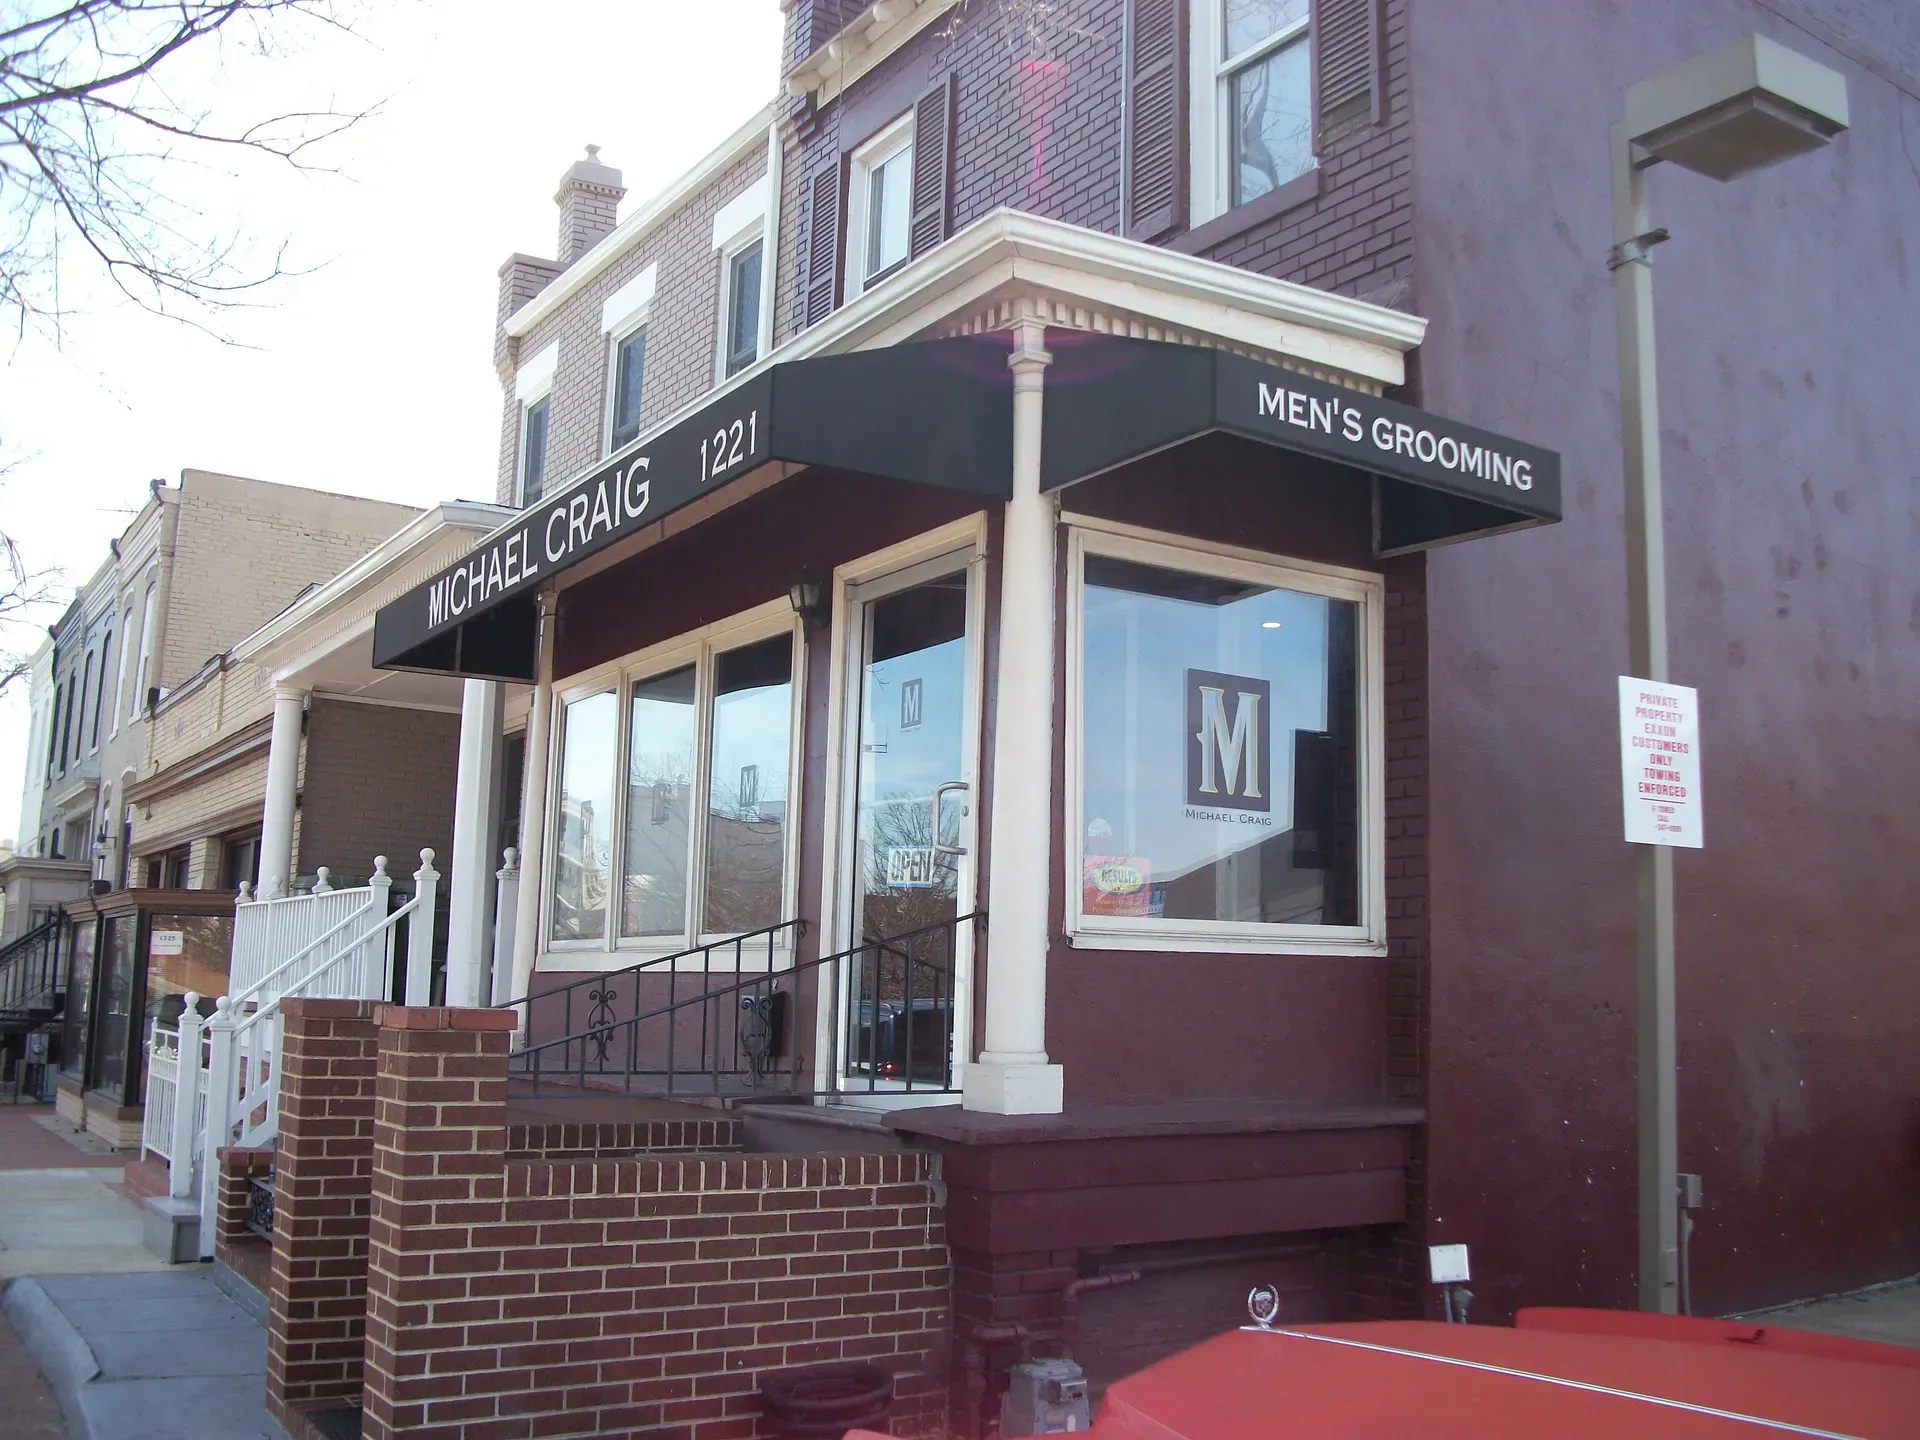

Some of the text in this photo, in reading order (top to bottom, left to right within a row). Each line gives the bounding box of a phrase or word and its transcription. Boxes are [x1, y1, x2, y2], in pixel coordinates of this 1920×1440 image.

[1258, 382, 1533, 491] MEN'S GROOMING
[428, 410, 757, 630] MICHAEL CRAIG 1221
[1640, 692, 1679, 708] PRIVATE
[1635, 707, 1683, 723] PROPERTY
[1645, 723, 1676, 737] EXXON
[1196, 685, 1262, 798] M
[1632, 736, 1689, 754] CUSTOMERS
[1650, 753, 1673, 766] ONLY
[1644, 767, 1681, 782] TOWING
[1638, 782, 1686, 798] ENFORCED
[891, 850, 931, 882] OPEN
